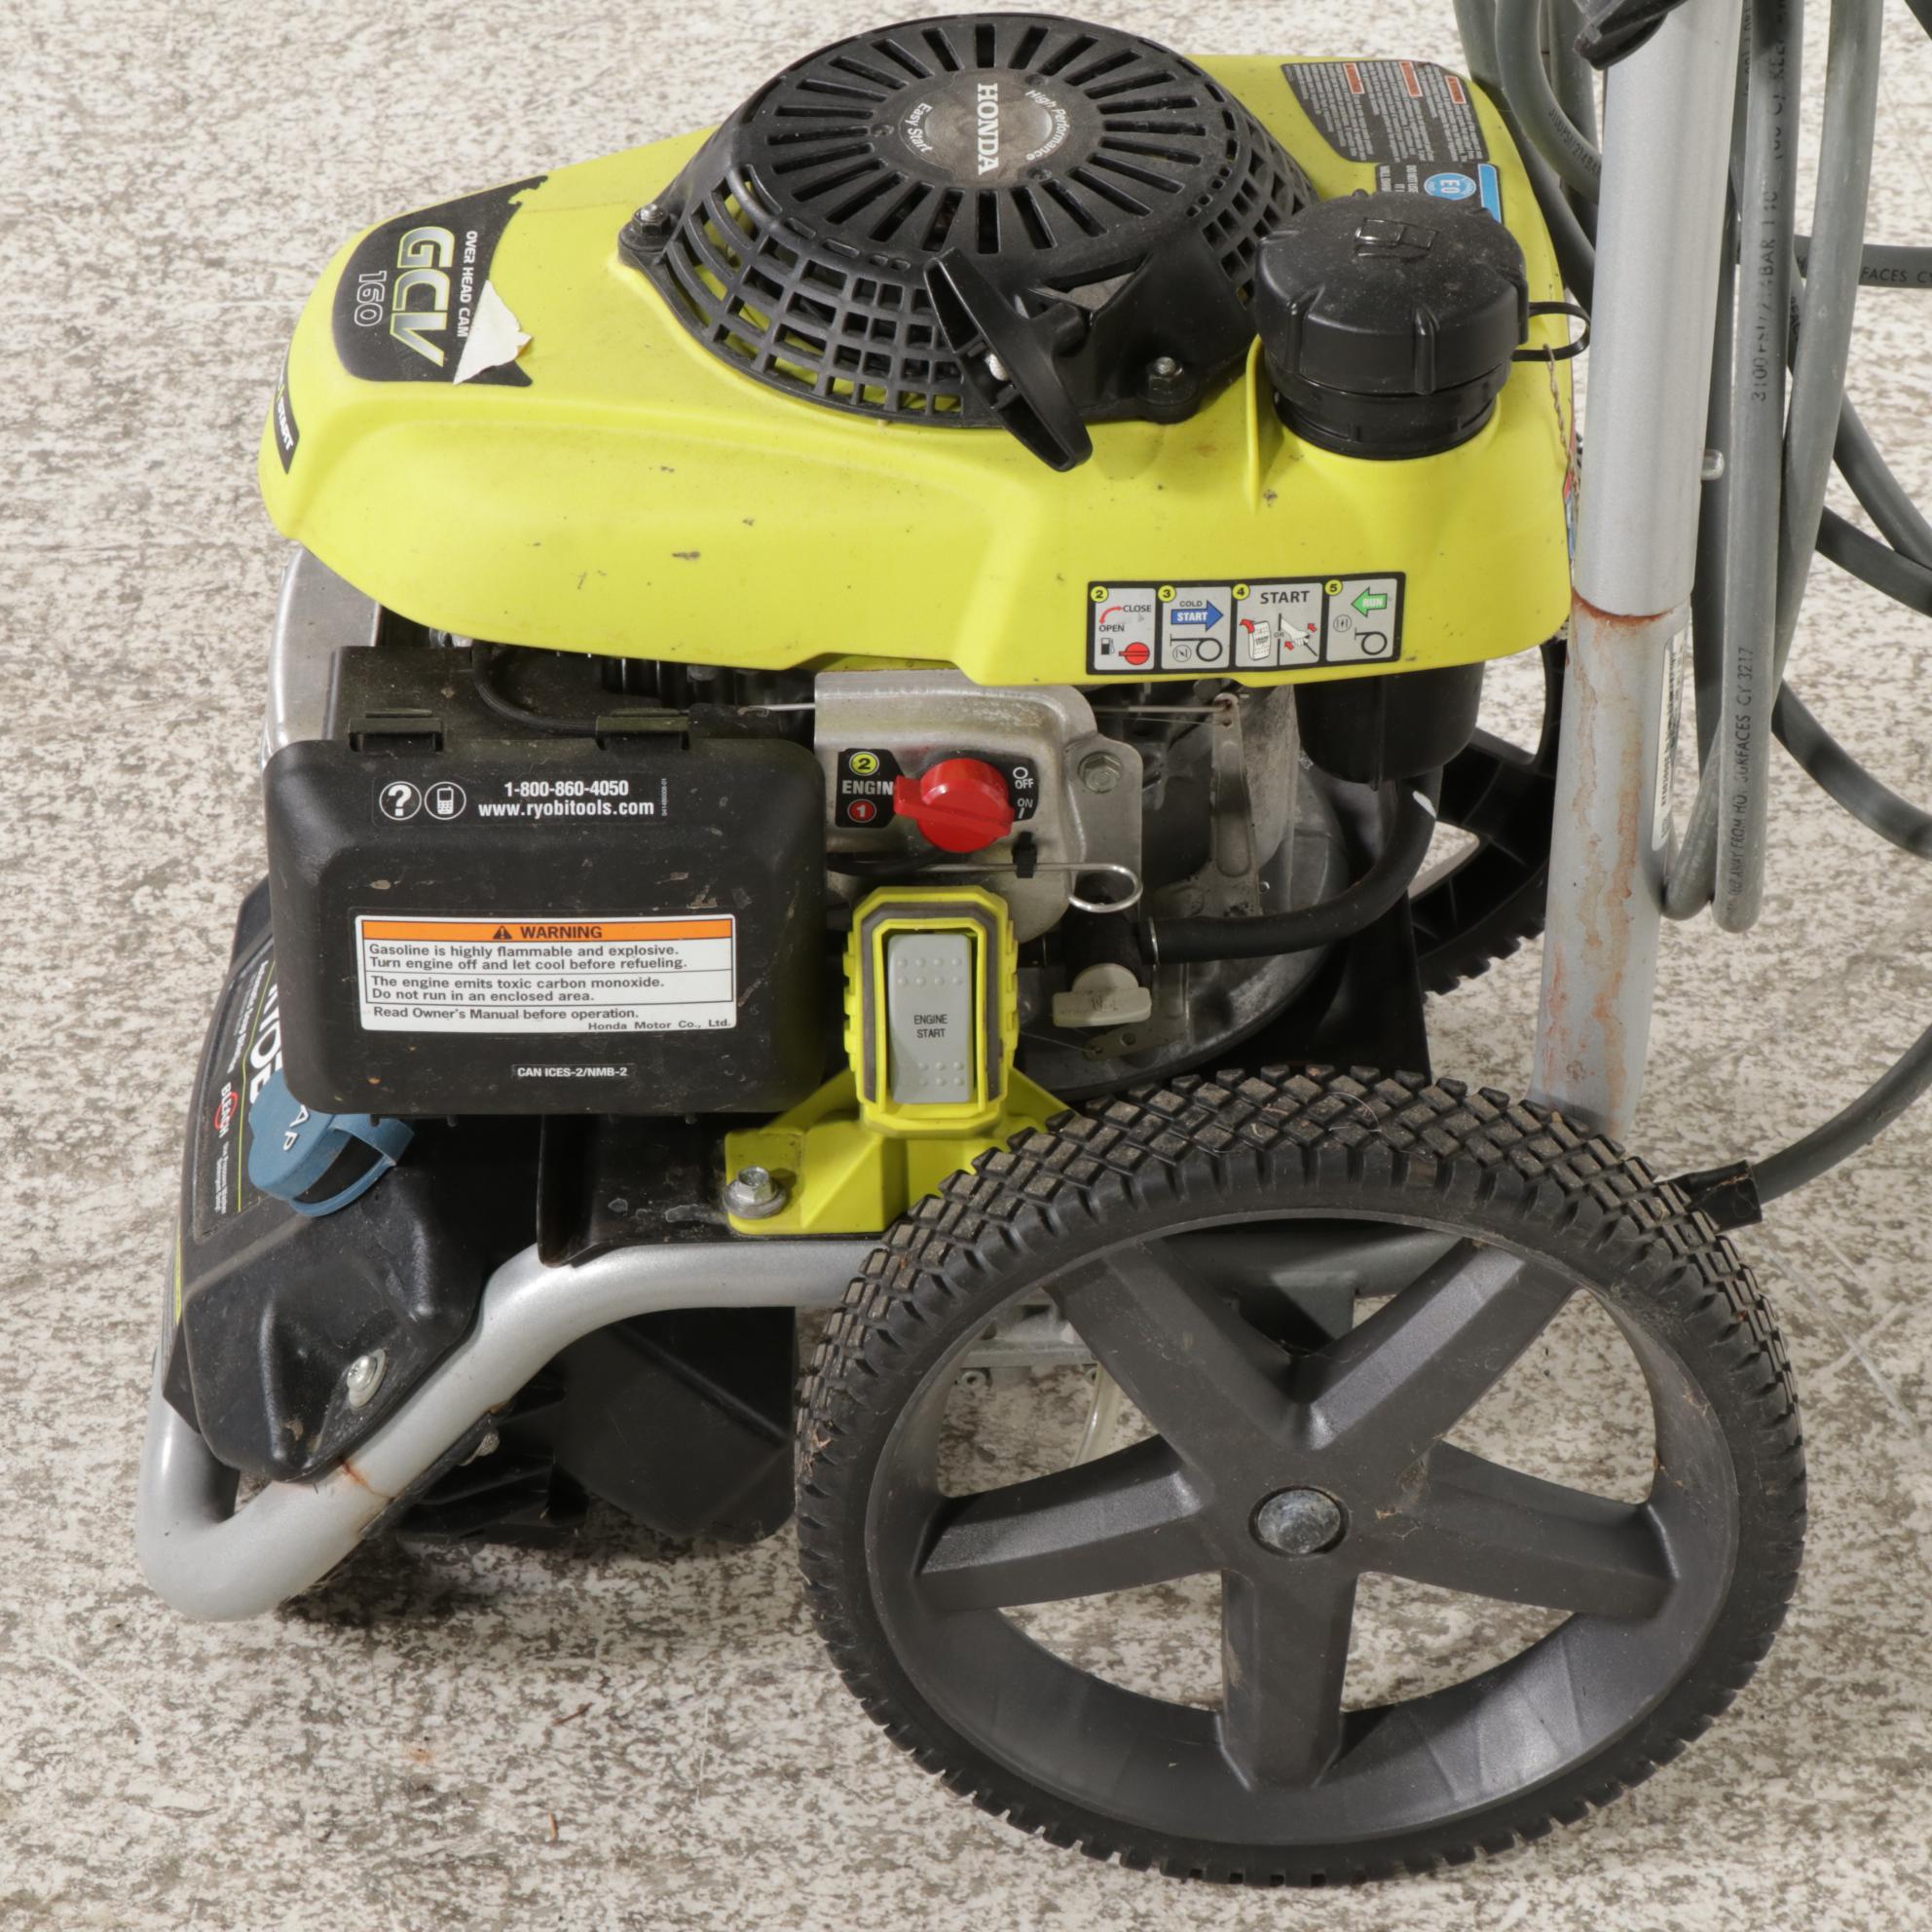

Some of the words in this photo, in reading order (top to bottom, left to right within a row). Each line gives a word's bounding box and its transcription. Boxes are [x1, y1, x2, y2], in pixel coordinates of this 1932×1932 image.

[1025, 90, 1057, 108] High
[905, 102, 933, 127] Easy
[978, 83, 999, 175] HONDA
[1026, 109, 1070, 161] Performance
[908, 129, 933, 152] Start
[464, 231, 477, 265] OVER
[1861, 267, 1908, 282] FACES
[461, 266, 474, 304] HEAD
[354, 270, 387, 326] 160
[390, 226, 455, 367] GCV
[457, 306, 471, 338] CAM
[1095, 589, 1104, 599] 2
[1162, 589, 1171, 599] 3
[1236, 586, 1245, 597] 4
[1329, 582, 1338, 593] 5
[1179, 600, 1203, 609] COLD
[1260, 590, 1310, 605] START
[1363, 597, 1383, 608] RUN
[1123, 604, 1152, 613] CLOSE
[1177, 611, 1208, 622] START
[1098, 624, 1125, 633] OPEN
[858, 758, 871, 770] 2
[505, 780, 628, 797] 1-800-860-4050
[842, 779, 893, 796] ENGIN
[1015, 779, 1034, 790] OFF
[478, 799, 653, 819] www.ryobitools.com
[1017, 798, 1033, 808] ON
[521, 926, 602, 939] WARNING
[369, 944, 428, 955] Gasoline
[434, 945, 445, 956] is
[451, 945, 493, 958] highly
[498, 945, 573, 957] flammable
[578, 945, 603, 956] and
[609, 945, 680, 958] explosive.
[370, 957, 401, 969] Turn
[406, 958, 453, 972] engine
[458, 958, 477, 970] off
[483, 958, 508, 970] and
[512, 958, 531, 970] let
[536, 958, 565, 970] cool
[570, 958, 615, 970] before
[621, 957, 687, 971] refueling.
[372, 976, 397, 987] The
[402, 977, 450, 990] engine
[455, 977, 493, 988] emits
[498, 977, 532, 988] toxic
[537, 977, 586, 988] carbon
[591, 976, 664, 988] monoxide.
[372, 988, 390, 1000] Do
[395, 989, 418, 1001] not
[423, 990, 446, 1001] run
[451, 989, 464, 1001] in
[469, 990, 485, 1001] an
[490, 989, 553, 1001] enclosed
[559, 991, 594, 1001] area.
[374, 1007, 407, 1018] Read
[413, 1007, 465, 1020] Owner's
[470, 1007, 519, 1020] Manual
[523, 1008, 567, 1020] before
[572, 1008, 639, 1021] operation.
[913, 1014, 947, 1025] ENGINE
[588, 1022, 627, 1031] Honda
[634, 1021, 671, 1030] Motor
[678, 1020, 701, 1030] Co.,
[708, 1020, 730, 1028] Ltd.
[917, 1027, 946, 1038] START
[545, 1067, 627, 1076] ICES-2/NMB-2
[219, 1081, 232, 1138] BLEACH
[282, 1104, 309, 1151] AP
